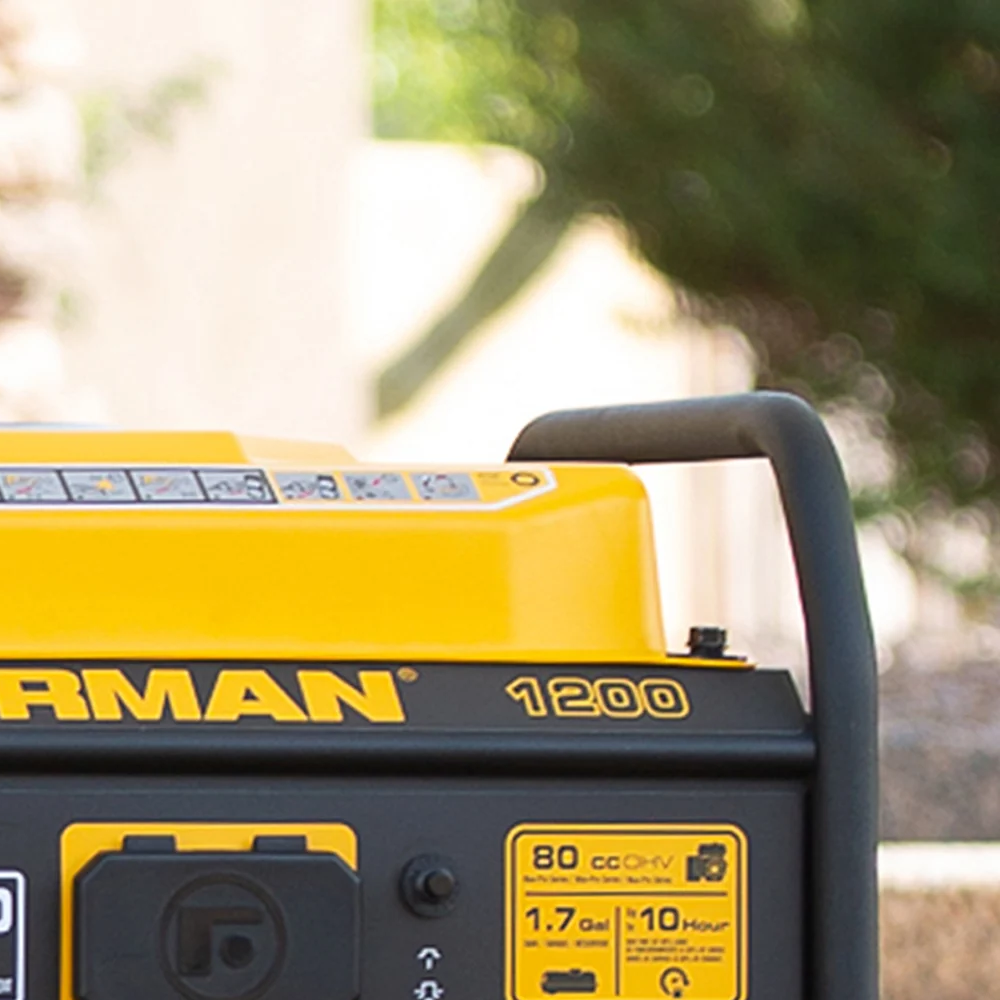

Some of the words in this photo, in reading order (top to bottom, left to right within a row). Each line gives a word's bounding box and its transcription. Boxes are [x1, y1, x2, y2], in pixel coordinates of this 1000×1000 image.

[505, 676, 691, 719] 1200
[532, 845, 579, 870] 80
[590, 856, 620, 870] cc
[525, 907, 576, 931] 1.7
[578, 918, 610, 932] Gal
[640, 907, 680, 931] 10
[682, 920, 730, 932] Hour
